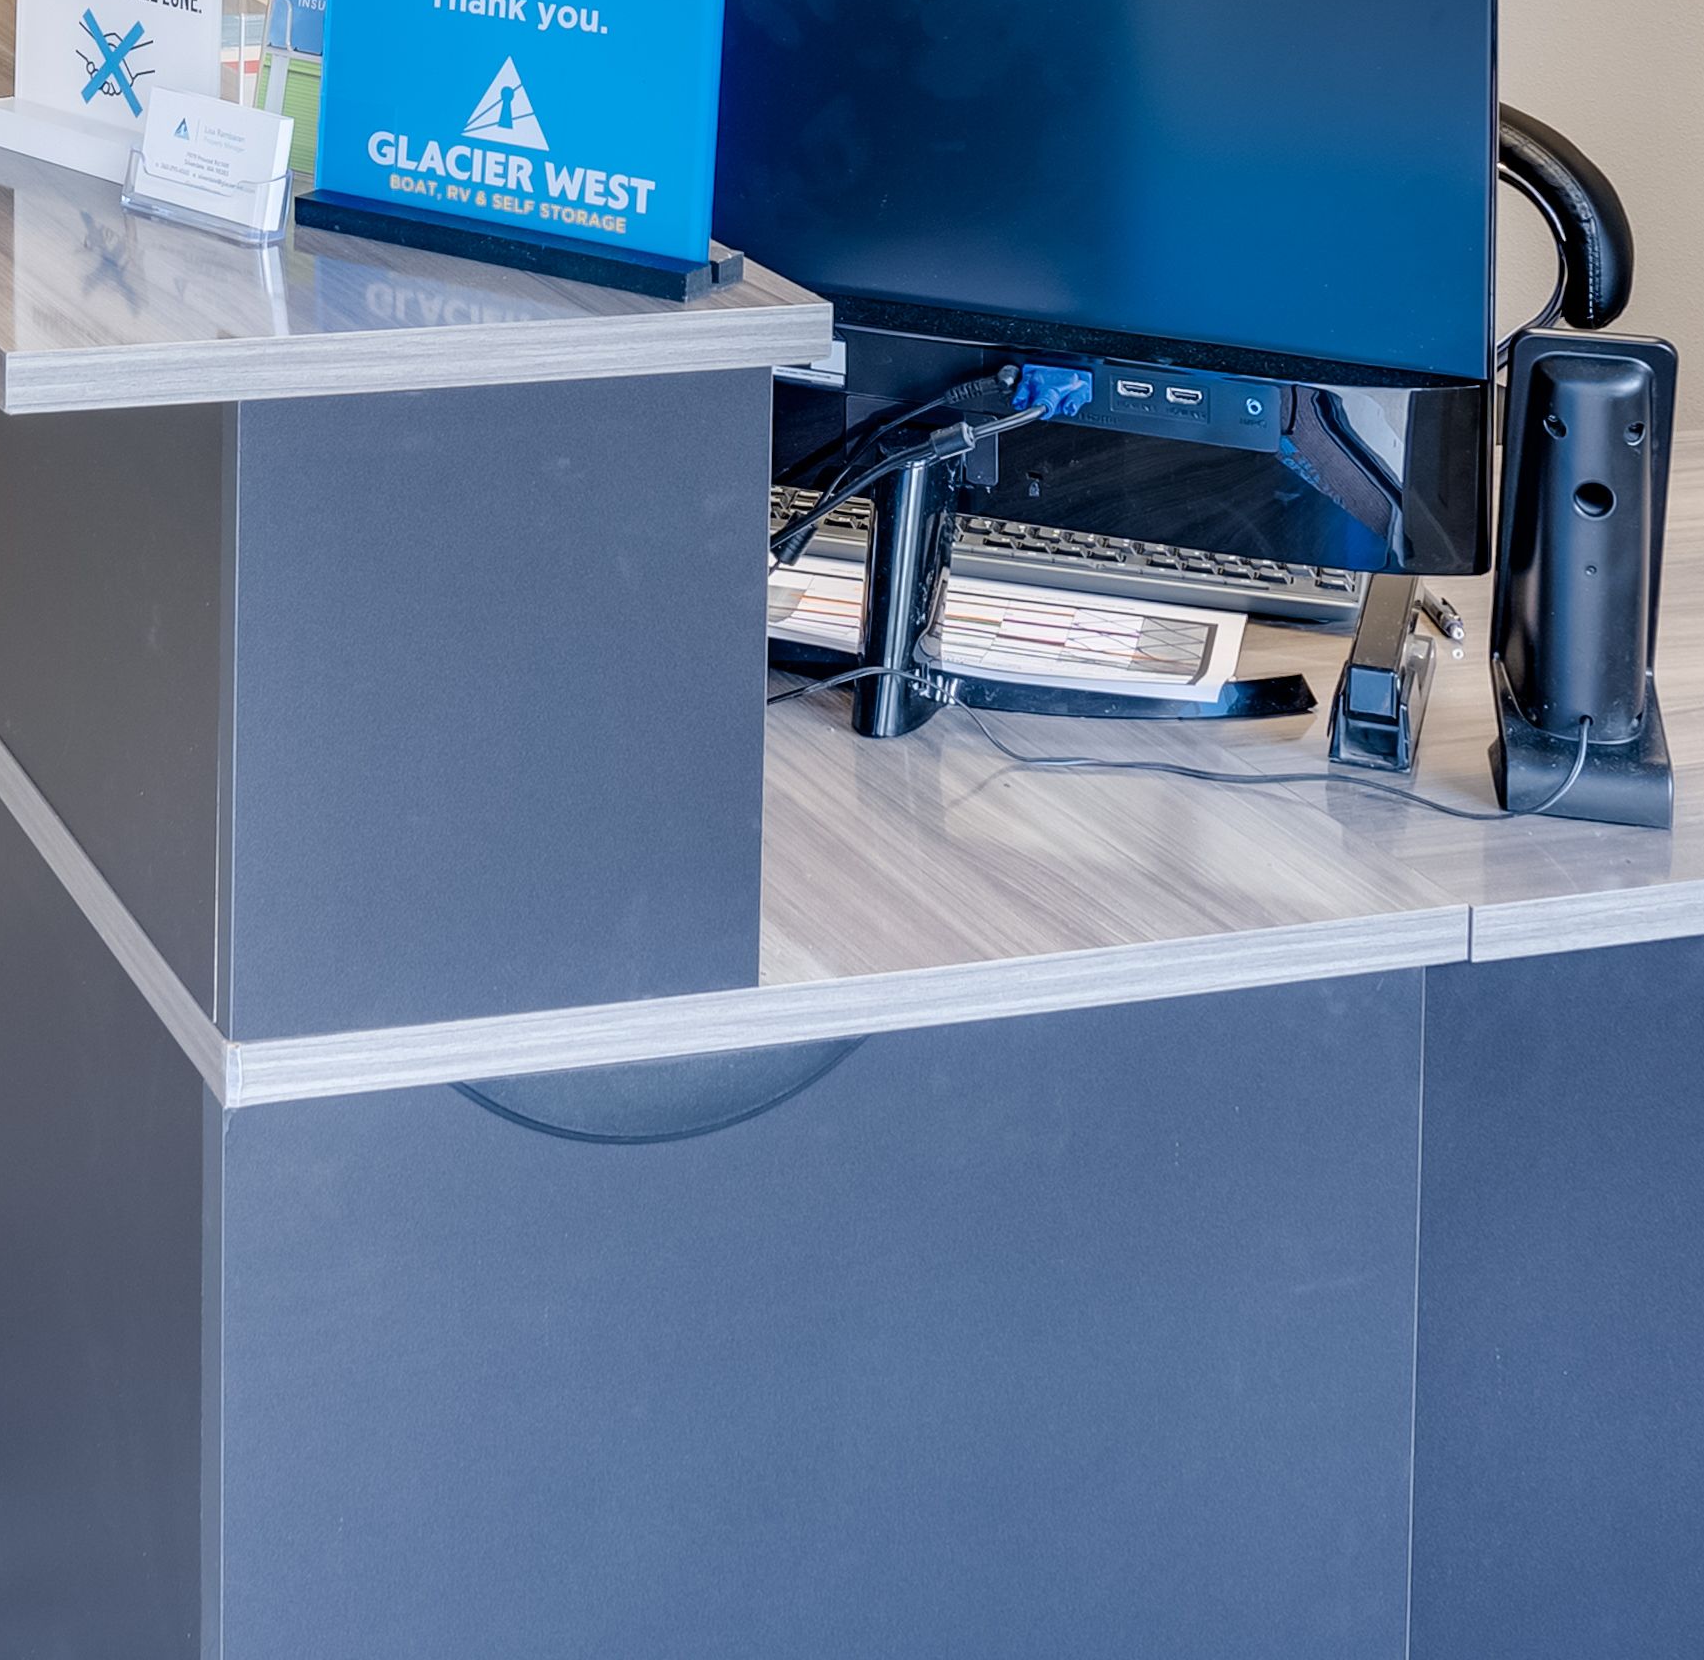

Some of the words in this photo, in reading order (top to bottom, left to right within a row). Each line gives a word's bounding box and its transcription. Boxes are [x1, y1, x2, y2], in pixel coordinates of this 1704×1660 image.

[537, 0, 608, 34] you.
[368, 131, 534, 193] GLACIER
[545, 161, 656, 214] WEST
[390, 174, 442, 201] BOAT,
[447, 185, 471, 202] RV
[475, 190, 487, 207] &
[492, 194, 535, 215] SELF
[539, 203, 627, 234] STORAGE
